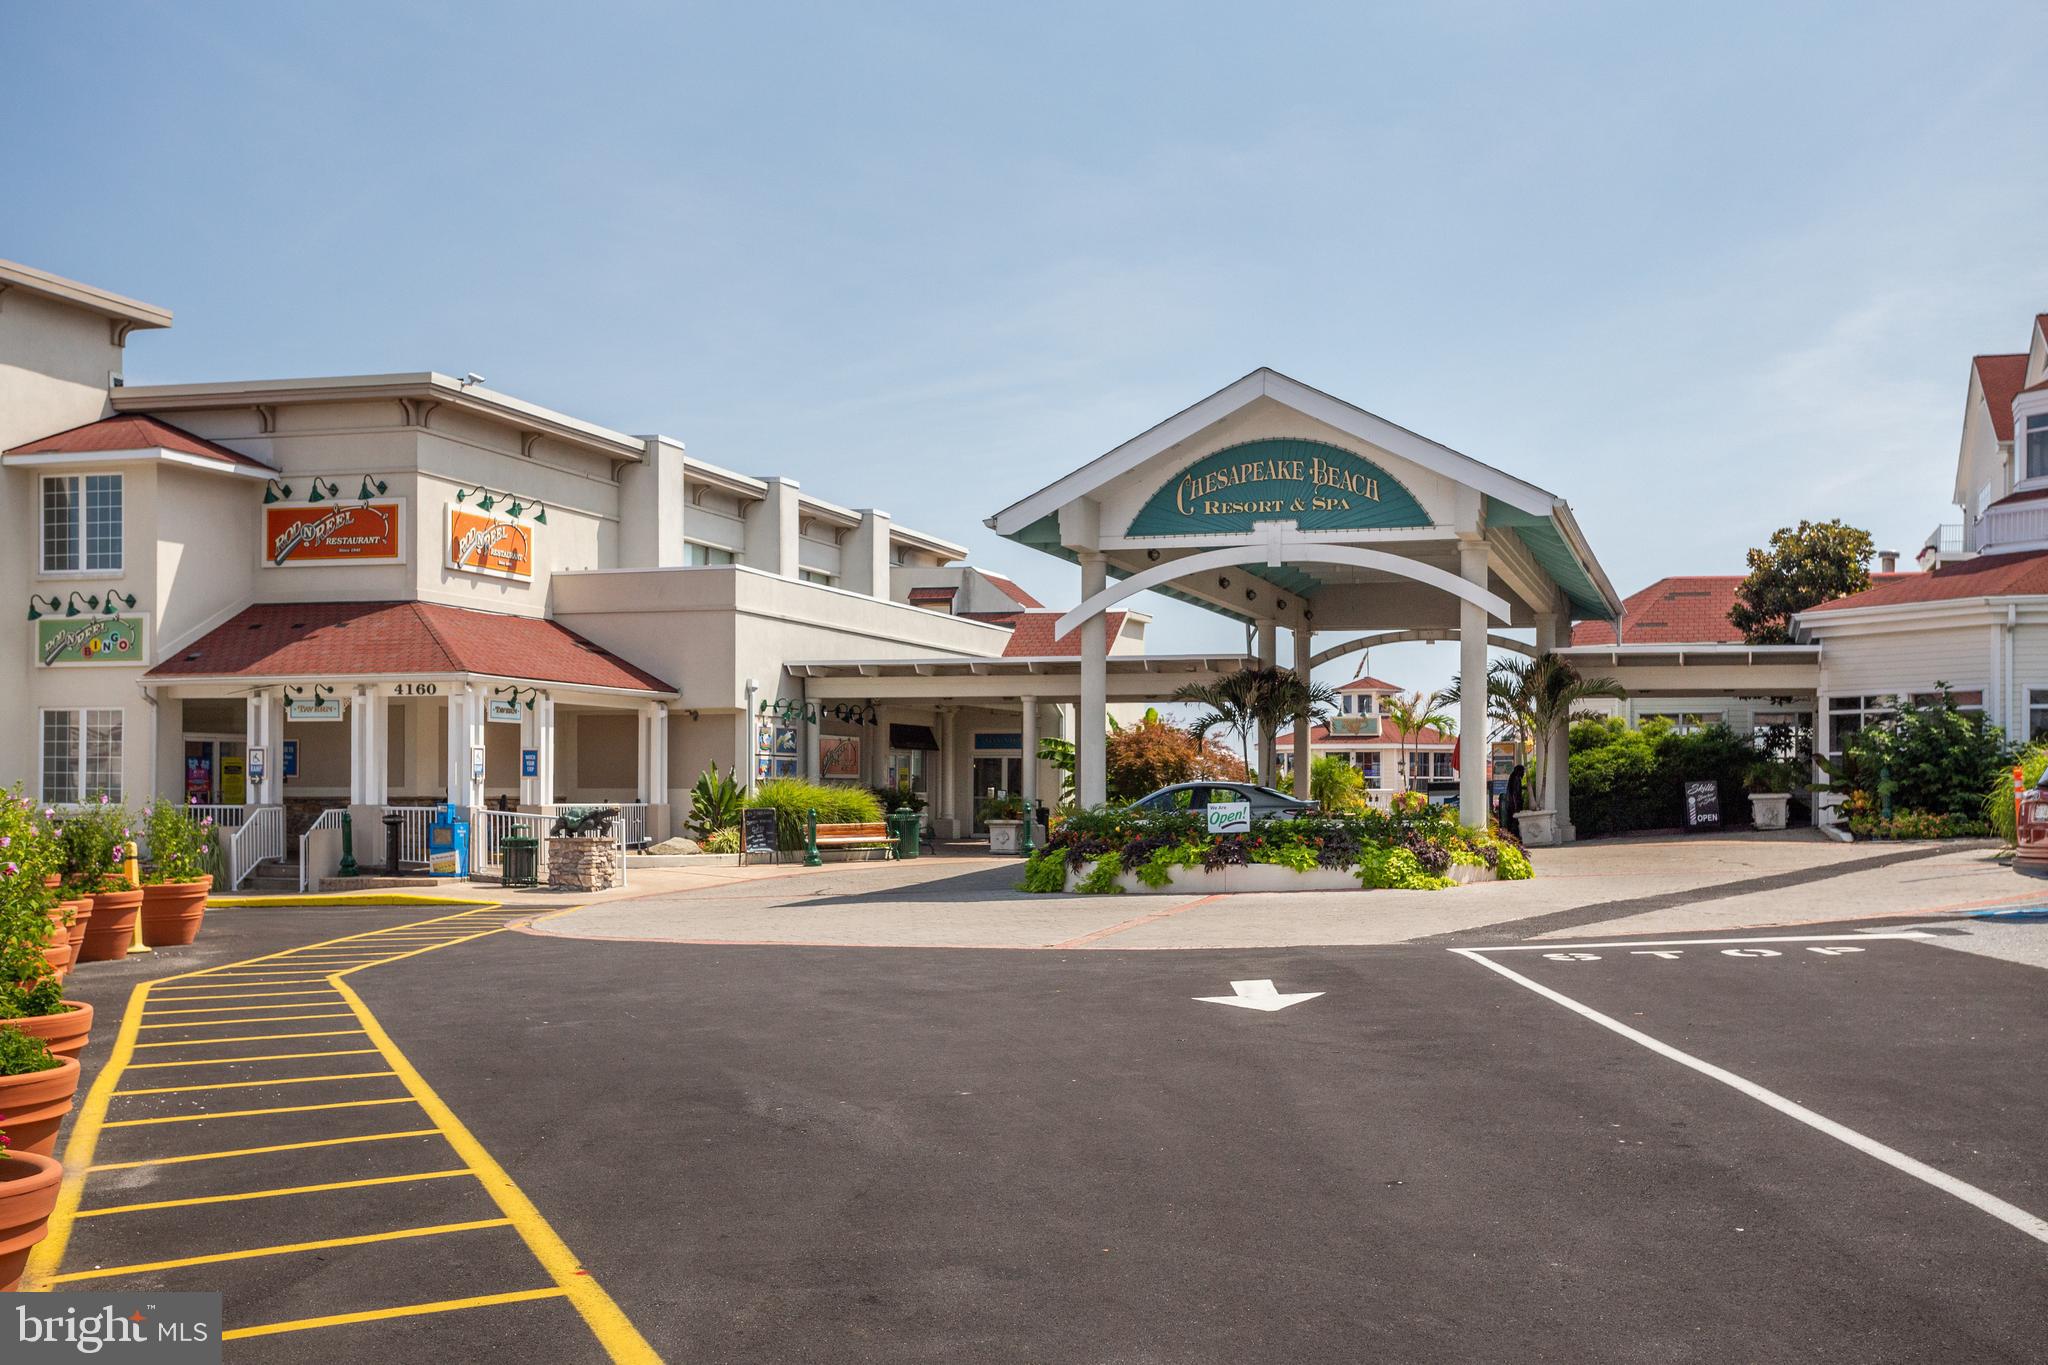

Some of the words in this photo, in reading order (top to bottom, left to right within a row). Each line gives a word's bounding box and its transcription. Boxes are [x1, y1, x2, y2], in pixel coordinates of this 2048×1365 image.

[1176, 457, 1305, 516] CHESAPEAKE
[1309, 457, 1380, 502] BEACH
[1204, 500, 1284, 515] RESORT
[1290, 498, 1305, 512] &
[1312, 496, 1351, 511] SPA
[275, 520, 301, 556] ROD
[315, 511, 355, 546] REEL
[326, 536, 381, 545] RESTAURANT
[84, 632, 129, 656] BINGO
[394, 683, 436, 695] 4160
[1210, 806, 1247, 827] Open!
[1697, 813, 1718, 822] OPEN
[1542, 946, 1866, 961] STOP
